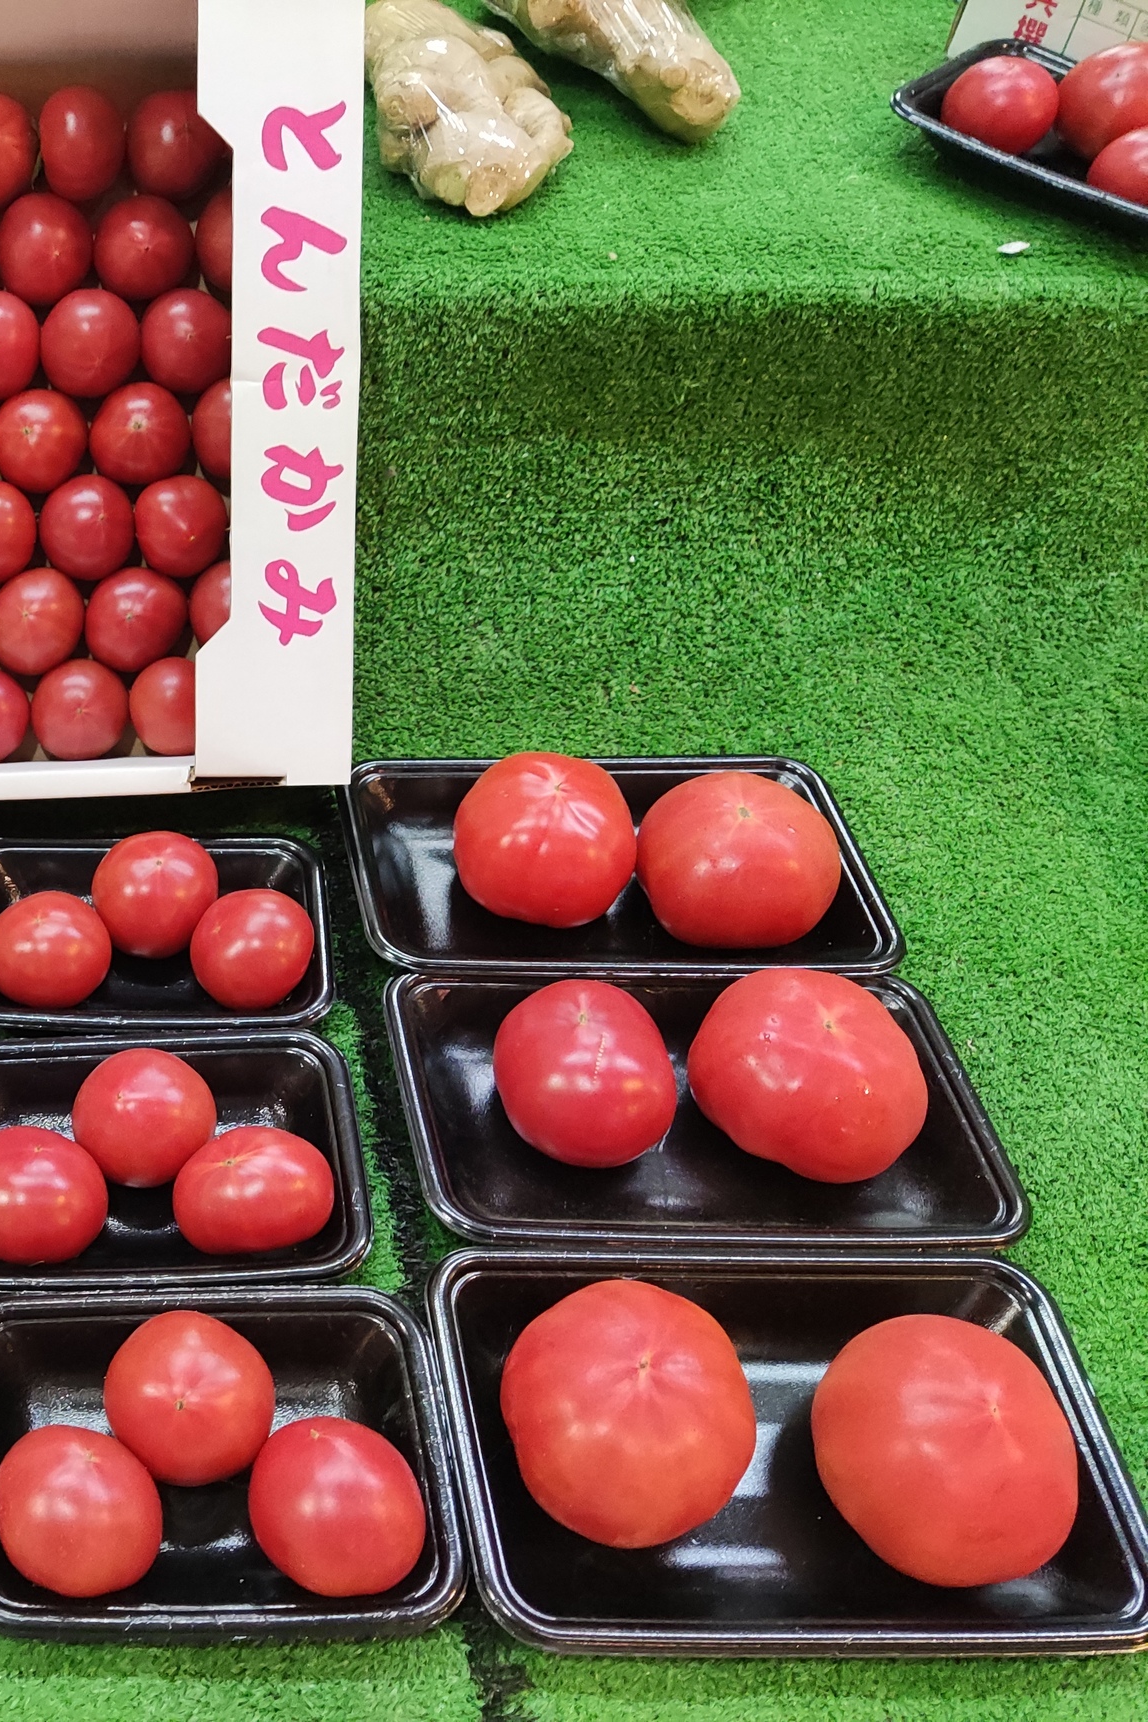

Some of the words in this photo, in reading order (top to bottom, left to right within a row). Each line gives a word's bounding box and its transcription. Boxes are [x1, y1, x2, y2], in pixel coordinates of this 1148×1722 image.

[256, 101, 347, 646] とんだかみ
